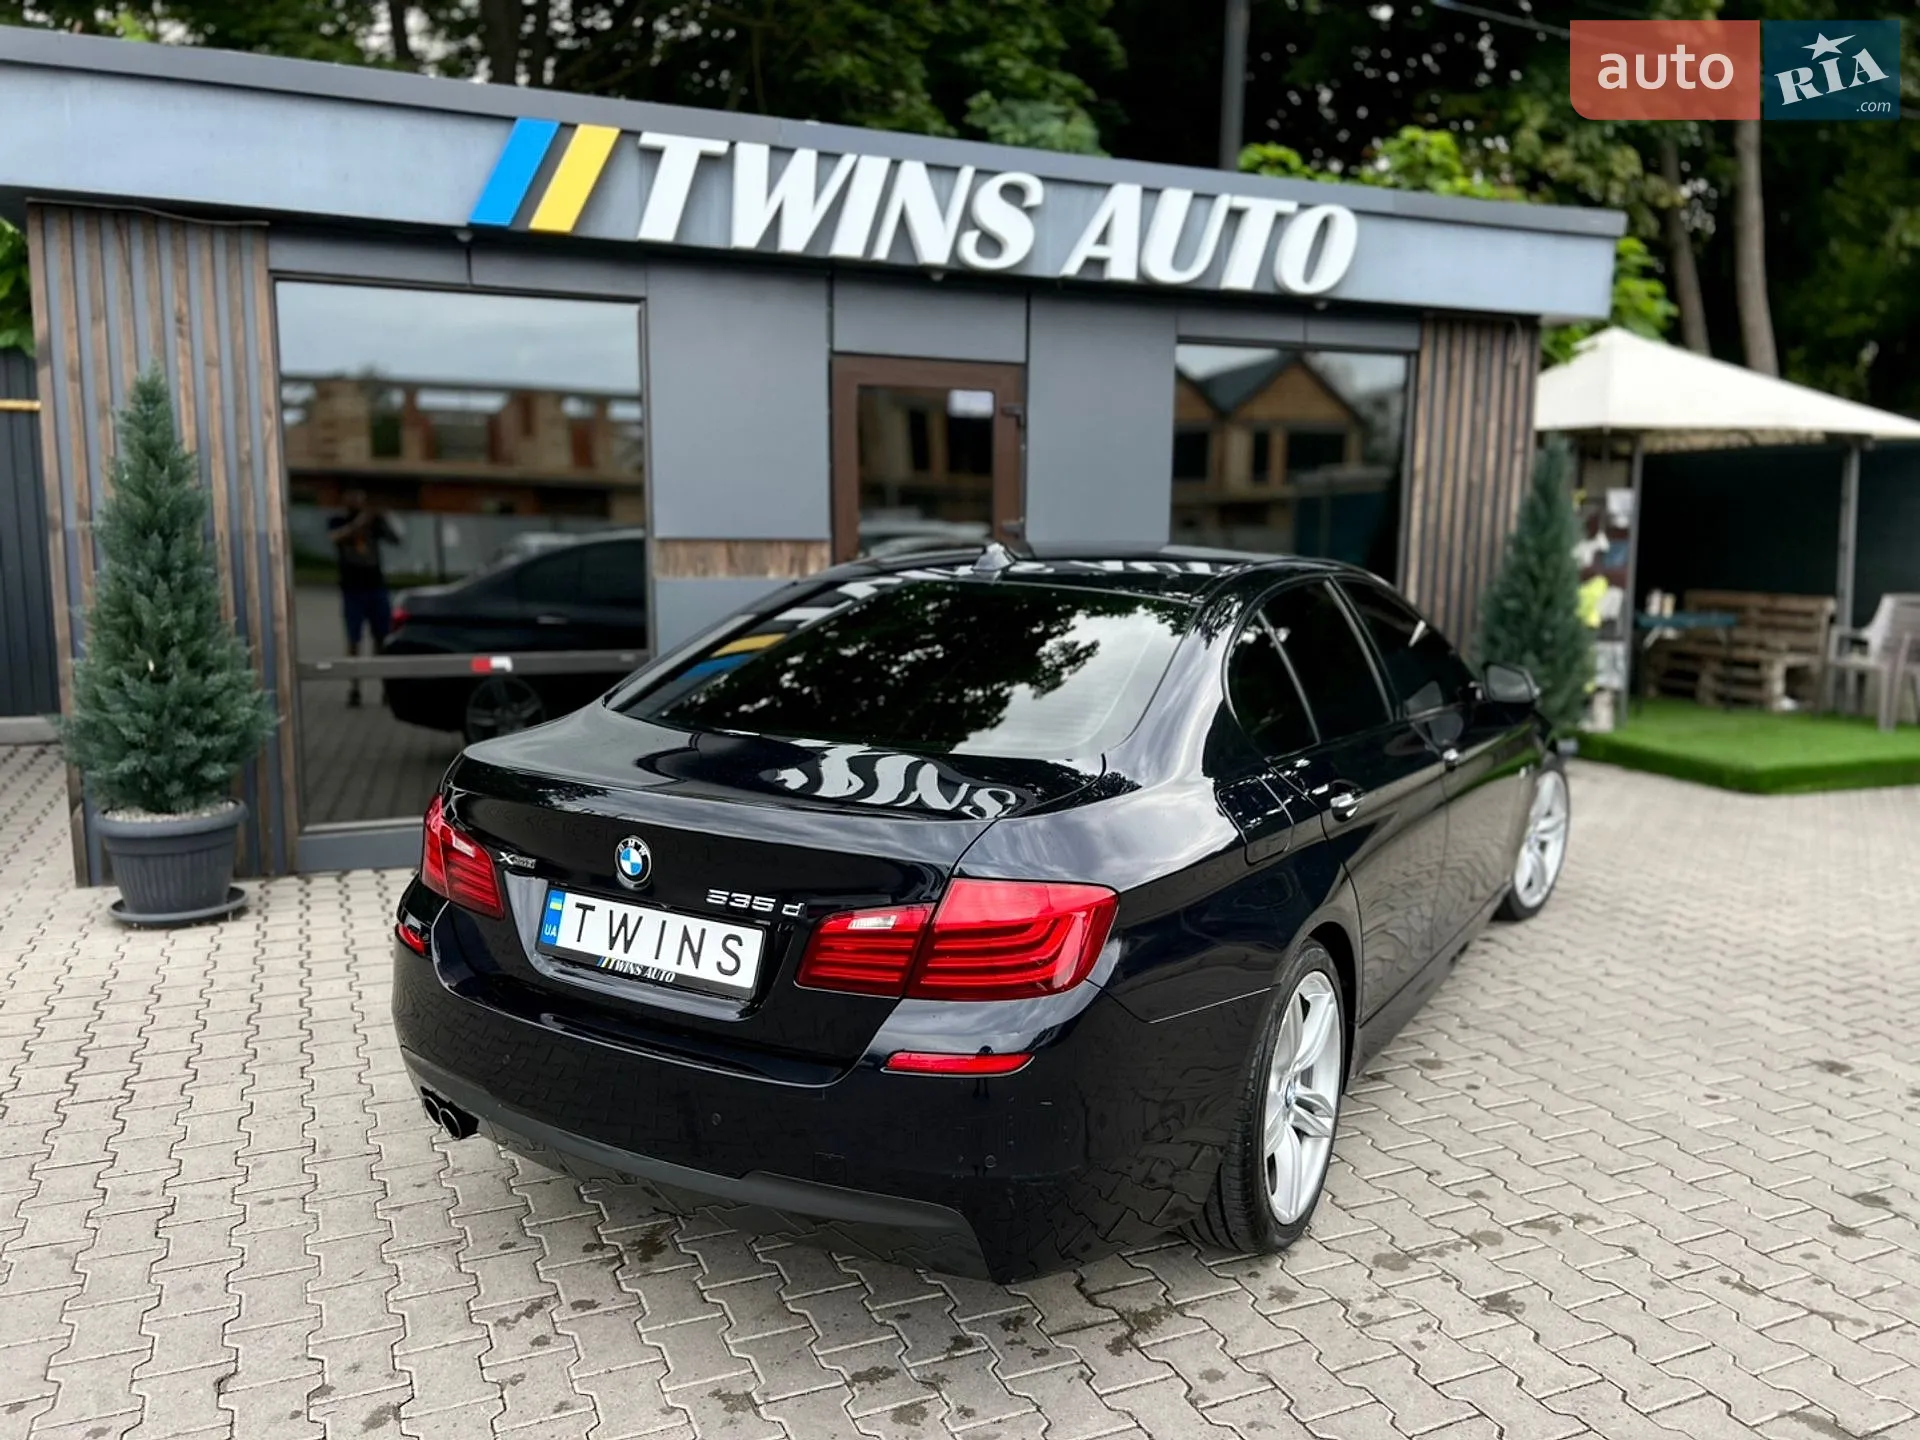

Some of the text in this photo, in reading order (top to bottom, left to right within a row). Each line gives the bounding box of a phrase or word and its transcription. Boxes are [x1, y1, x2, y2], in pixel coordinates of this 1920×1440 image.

[637, 131, 1358, 296] TWINS AUTO
[544, 923, 558, 938] UA
[574, 902, 744, 976] TWINS
[608, 957, 676, 983] TWINS AUTO
